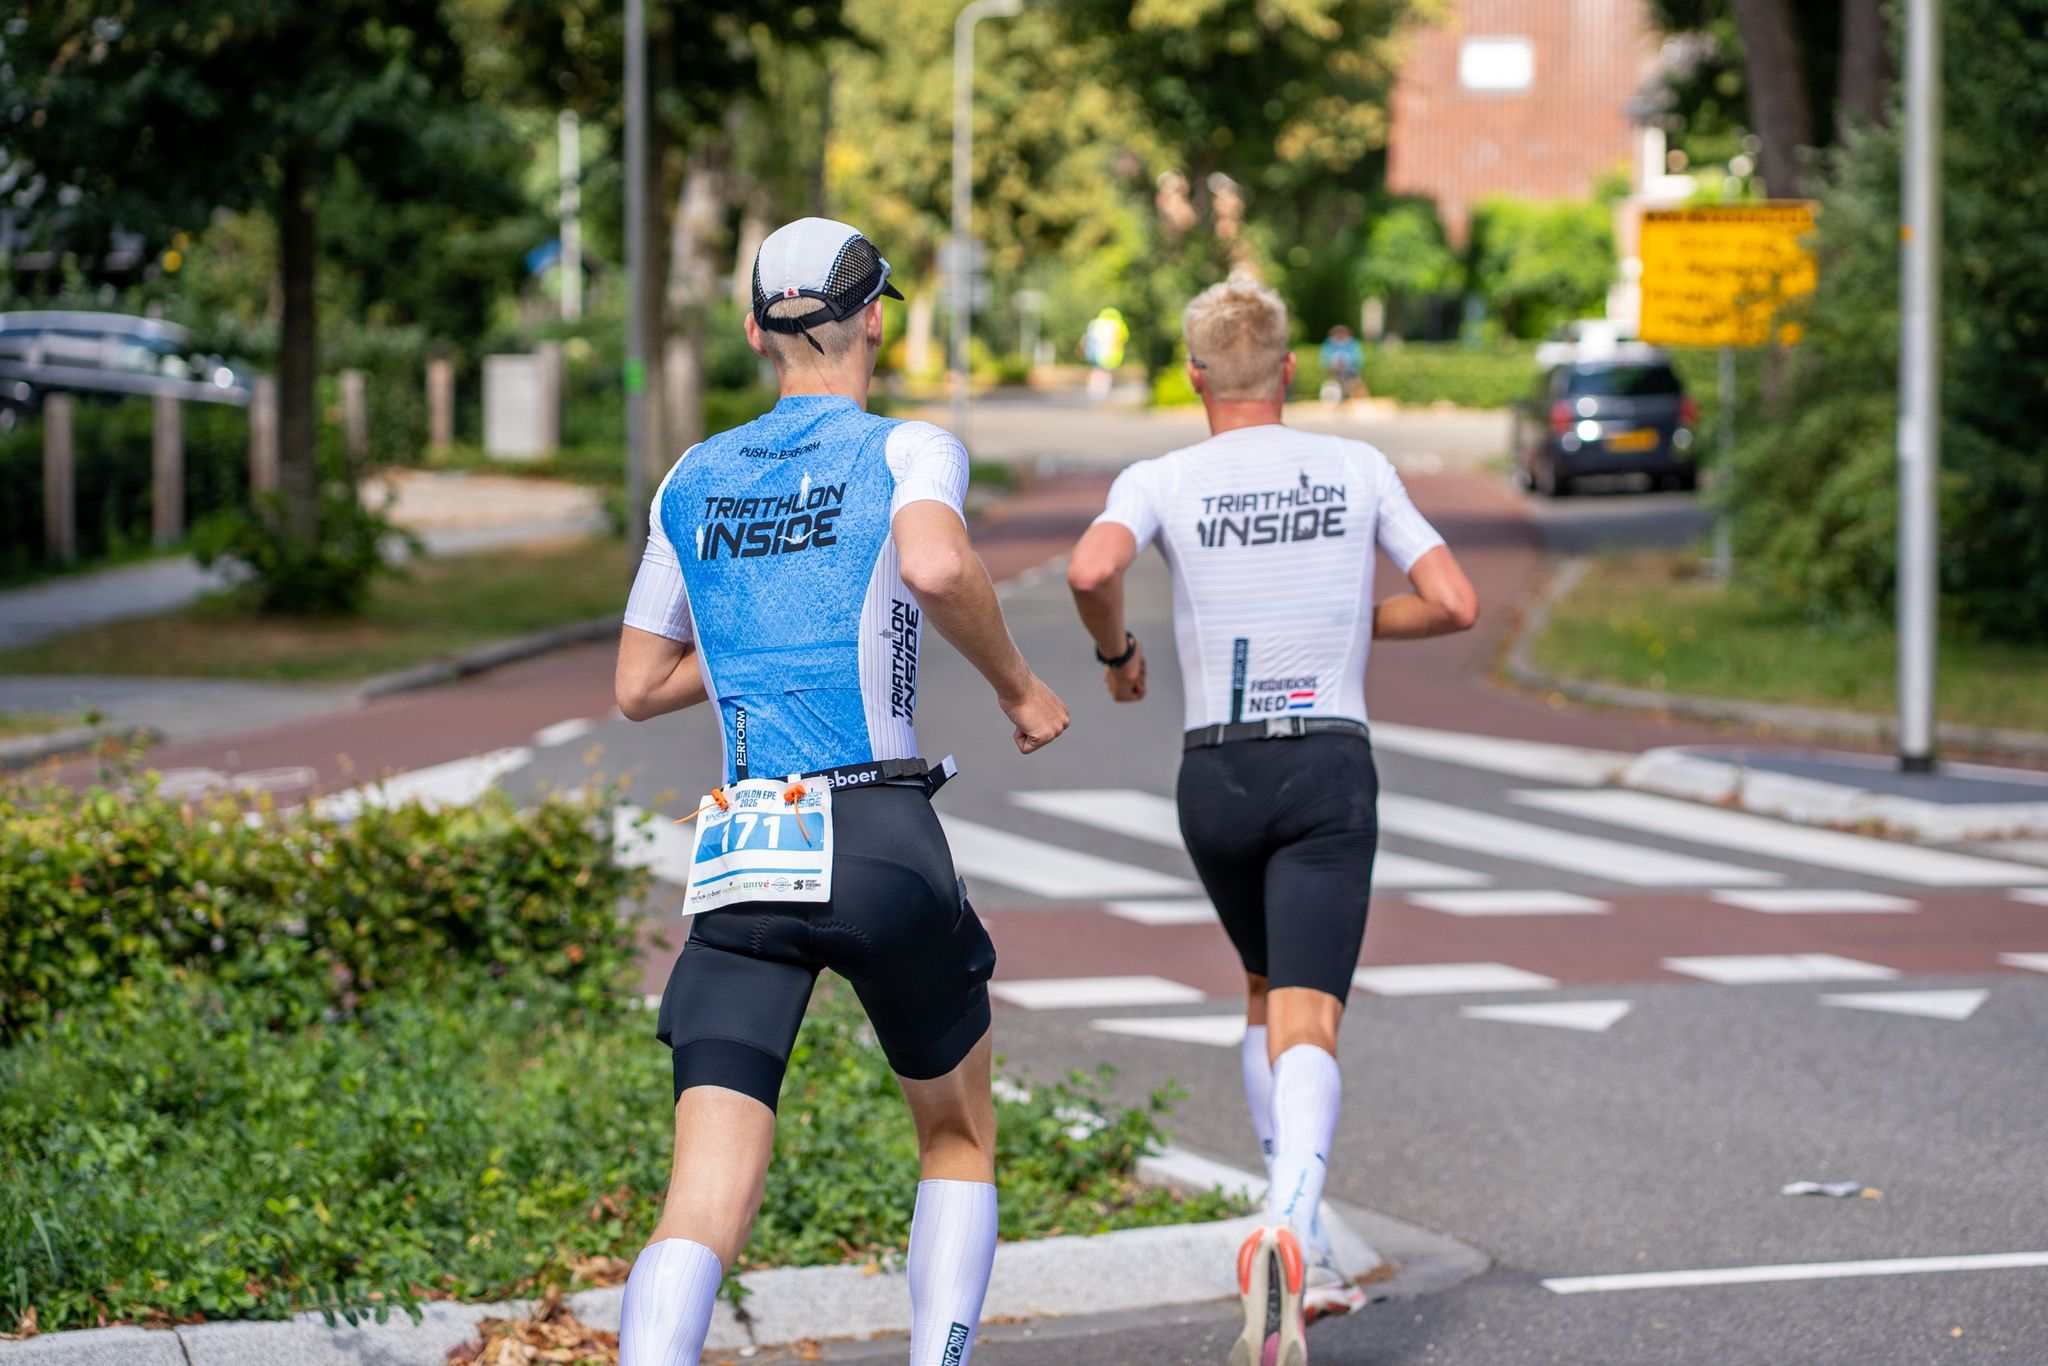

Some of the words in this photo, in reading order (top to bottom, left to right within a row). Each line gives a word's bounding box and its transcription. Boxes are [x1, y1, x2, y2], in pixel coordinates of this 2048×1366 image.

[739, 447, 768, 459] PUSH
[704, 482, 847, 519] TRIATHLON
[1201, 484, 1346, 514] TRIATHLON
[700, 506, 842, 561] INSIDE
[1206, 506, 1348, 548] INSIDE
[891, 599, 905, 718] TRIATHLON
[904, 602, 920, 722] INSIDE
[1249, 695, 1288, 713] NED
[736, 709, 747, 767] PERFORM
[722, 813, 781, 853] 171
